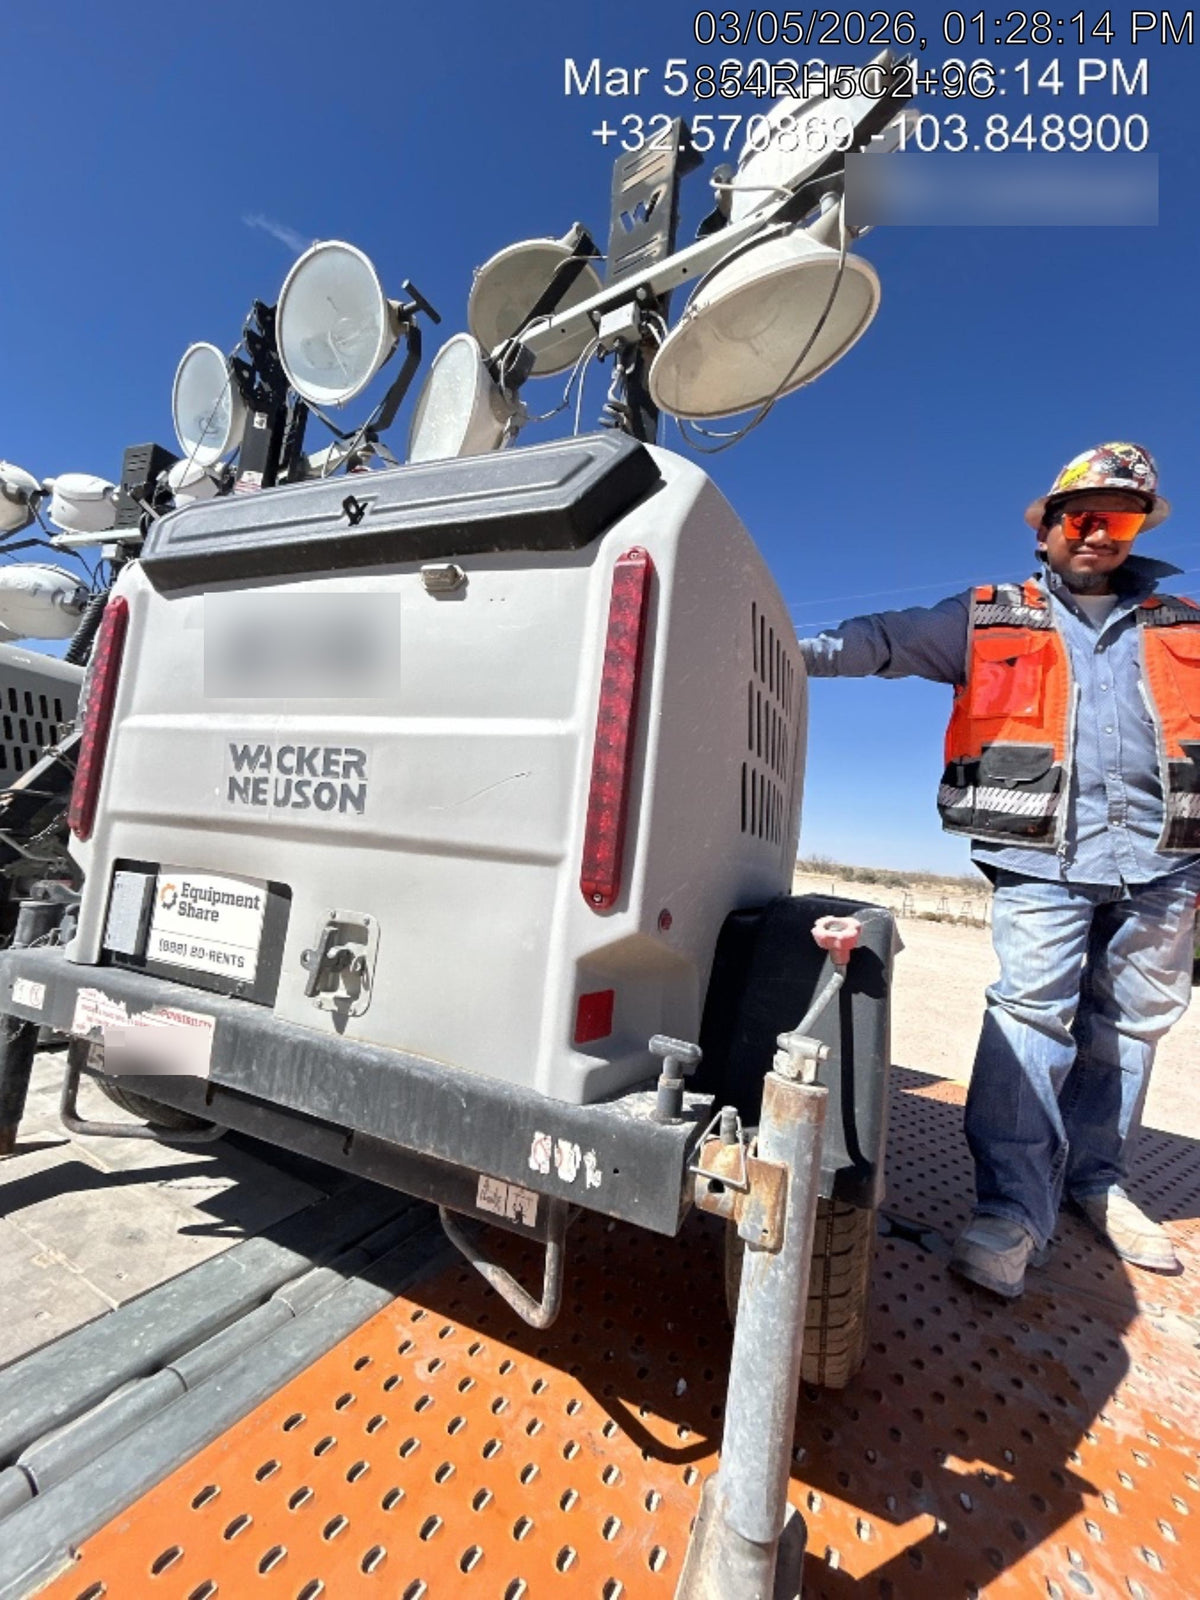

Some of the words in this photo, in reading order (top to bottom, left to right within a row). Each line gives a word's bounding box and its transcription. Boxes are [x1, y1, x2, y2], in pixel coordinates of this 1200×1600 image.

[229, 742, 368, 781] WACKER
[227, 775, 367, 815] NEUSON
[177, 901, 220, 922] Share
[180, 881, 262, 911] Equipment
